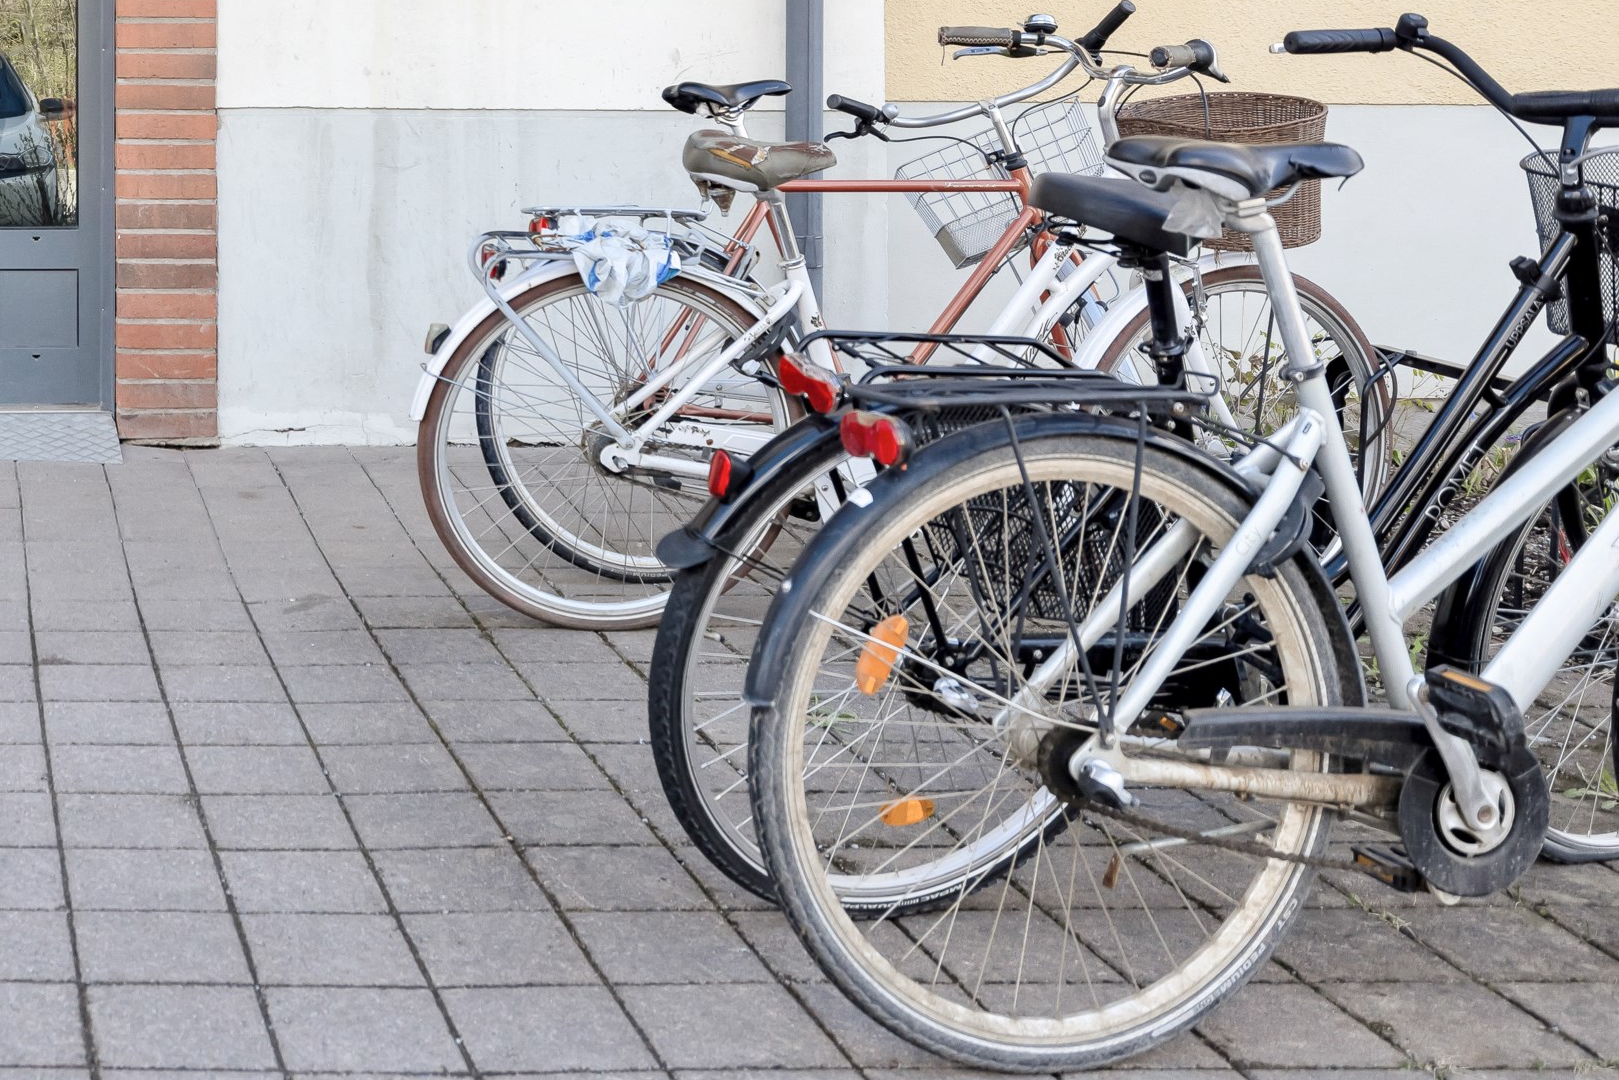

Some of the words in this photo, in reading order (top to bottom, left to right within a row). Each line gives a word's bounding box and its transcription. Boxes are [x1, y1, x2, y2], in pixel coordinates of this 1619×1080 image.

[1505, 300, 1543, 349] UPPSALA
[1278, 897, 1299, 931] CST
[1220, 943, 1268, 993] PEDIUM
